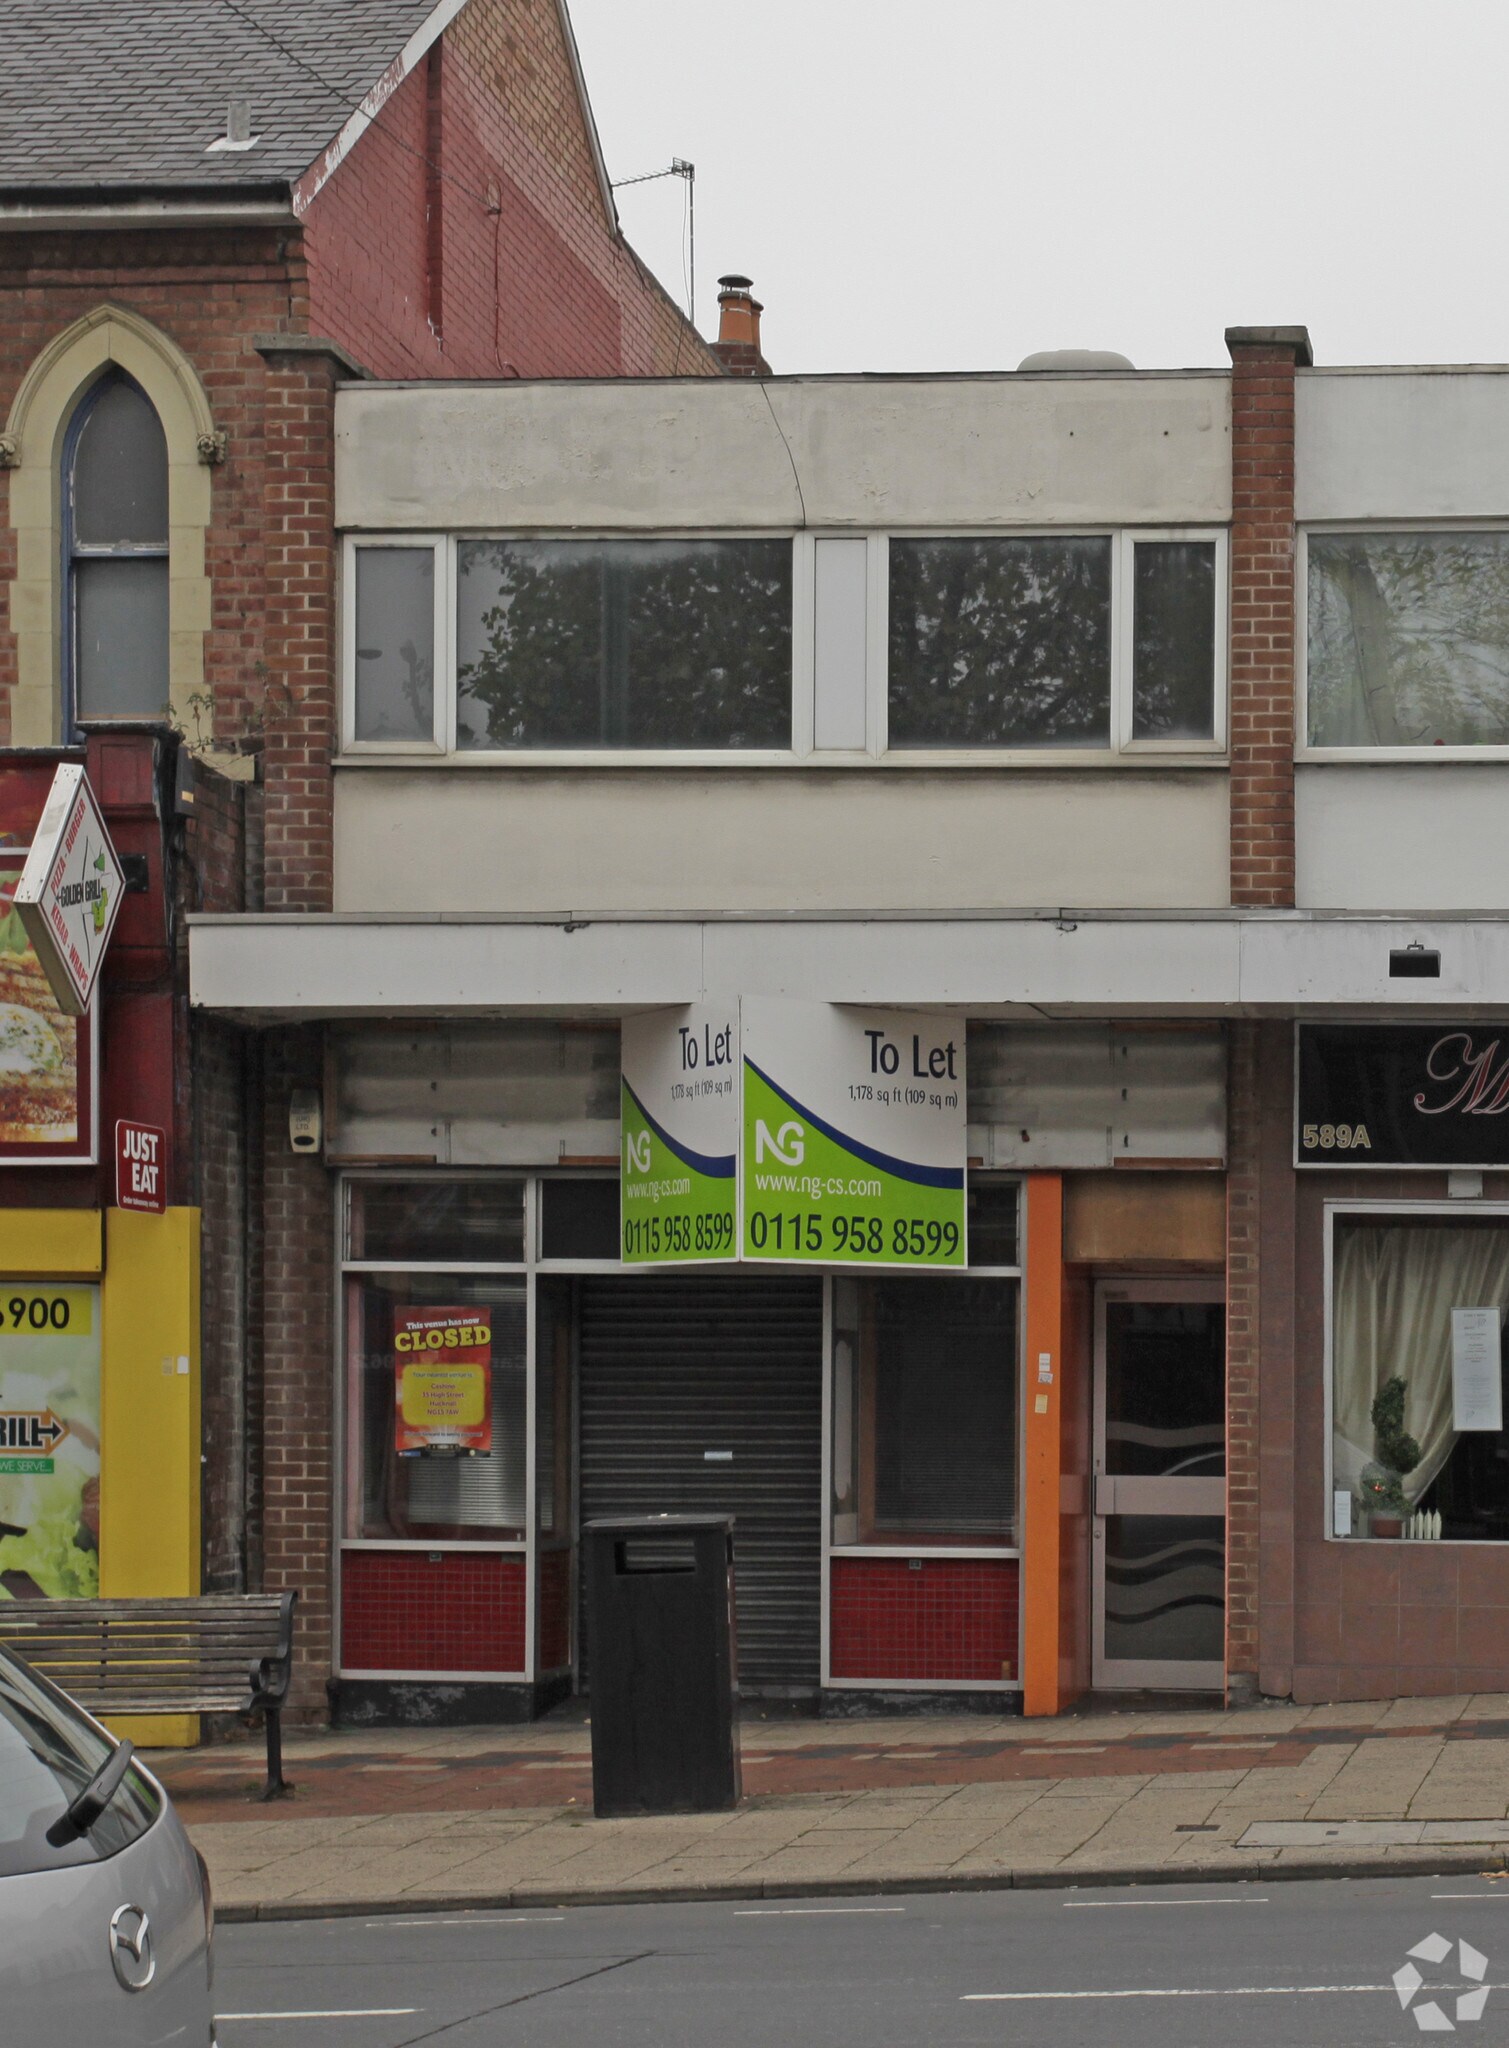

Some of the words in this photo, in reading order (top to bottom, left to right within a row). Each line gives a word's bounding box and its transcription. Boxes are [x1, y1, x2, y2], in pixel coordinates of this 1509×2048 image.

[51, 861, 66, 895] PIZZA
[65, 797, 86, 851] BURGER
[61, 883, 84, 908] GOLDEN
[51, 904, 69, 944] KEBAB
[69, 947, 89, 991] WRAPS
[679, 1026, 698, 1071] To
[705, 1023, 733, 1067] Let
[864, 1030, 900, 1074] To
[913, 1034, 958, 1080] Let
[686, 1086, 694, 1101] sq
[695, 1081, 700, 1096] ft
[715, 1081, 722, 1098] sq
[848, 1085, 873, 1101] 1,178
[877, 1090, 890, 1106] sq
[893, 1087, 902, 1103] ft
[905, 1089, 926, 1105] (109
[929, 1093, 942, 1110] sq
[945, 1091, 958, 1110] m)
[123, 1129, 158, 1163] JUST
[627, 1129, 651, 1174] NG
[755, 1119, 805, 1166] NG
[1303, 1124, 1372, 1149] 589A
[132, 1162, 159, 1195] EAT
[627, 1177, 691, 1203] www.ng-cs.com
[755, 1174, 881, 1200] www.ng-cs.com
[625, 1216, 660, 1254] 0115
[664, 1214, 691, 1252] 958
[695, 1211, 733, 1251] 8599
[750, 1211, 823, 1251] 0115
[832, 1215, 884, 1254] 958
[893, 1218, 960, 1257] 8599
[0, 1297, 70, 1329] 900
[406, 1321, 424, 1330] This
[424, 1320, 448, 1329] venue
[448, 1318, 462, 1326] has
[463, 1317, 480, 1325] now
[395, 1325, 491, 1352] CLOSED
